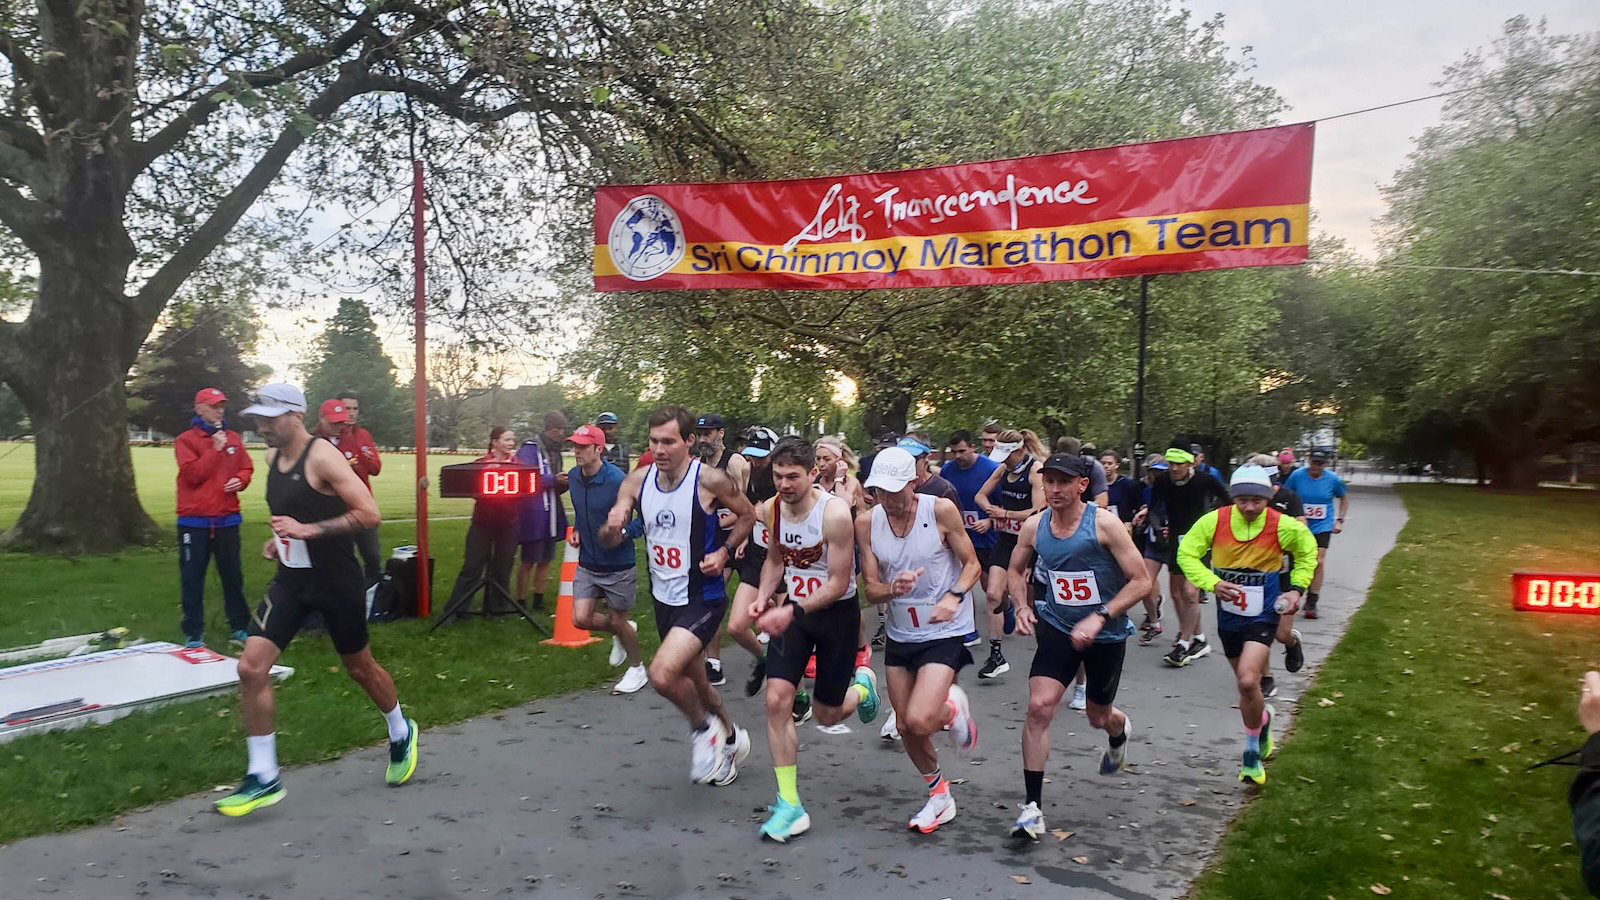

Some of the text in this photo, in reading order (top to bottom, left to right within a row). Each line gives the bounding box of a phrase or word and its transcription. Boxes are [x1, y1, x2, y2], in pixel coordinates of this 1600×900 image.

[691, 217, 1291, 277] Sri Chinmoy Marathon Team
[1306, 507, 1323, 517] 36
[785, 532, 802, 545] UC
[652, 545, 681, 569] 38
[792, 575, 822, 598] 20
[1056, 578, 1092, 600] 35
[1232, 591, 1248, 612] 4
[907, 607, 919, 628] 1
